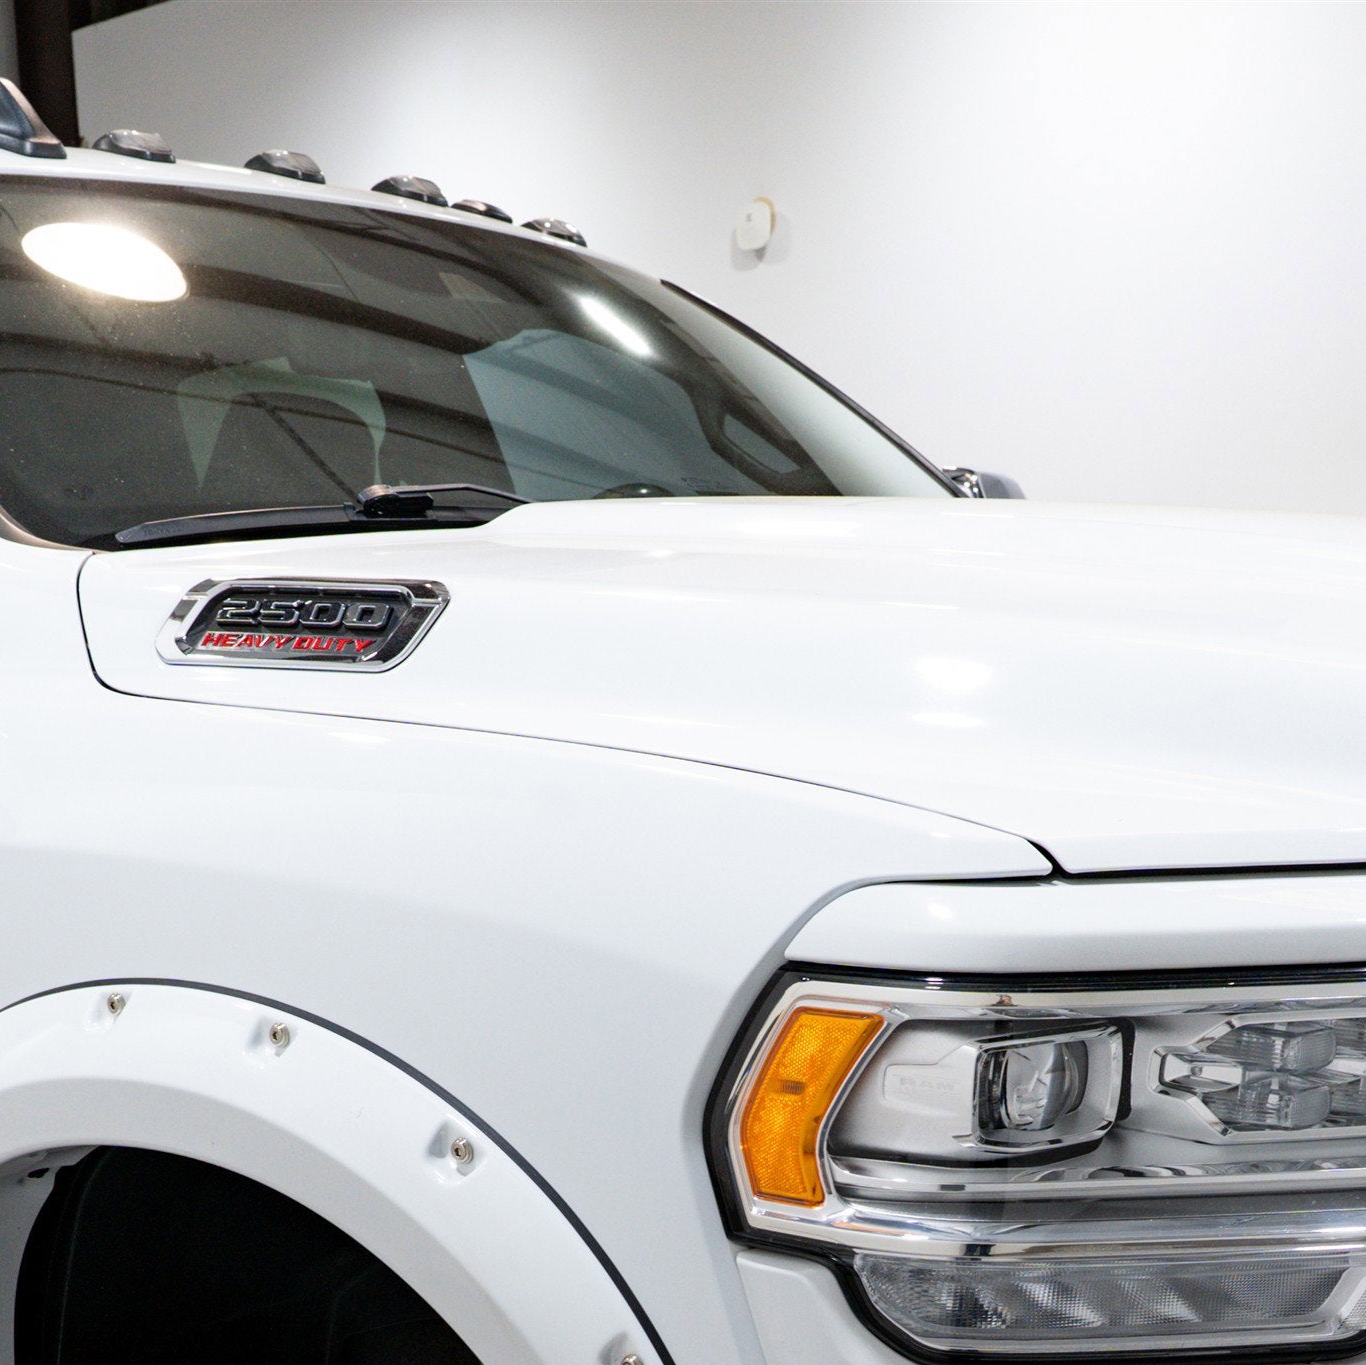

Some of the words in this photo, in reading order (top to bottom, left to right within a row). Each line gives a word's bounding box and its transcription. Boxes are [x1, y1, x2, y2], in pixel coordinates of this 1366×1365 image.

[215, 598, 394, 630] 2500
[199, 631, 295, 650] HEAVY
[291, 636, 378, 653] DUTY
